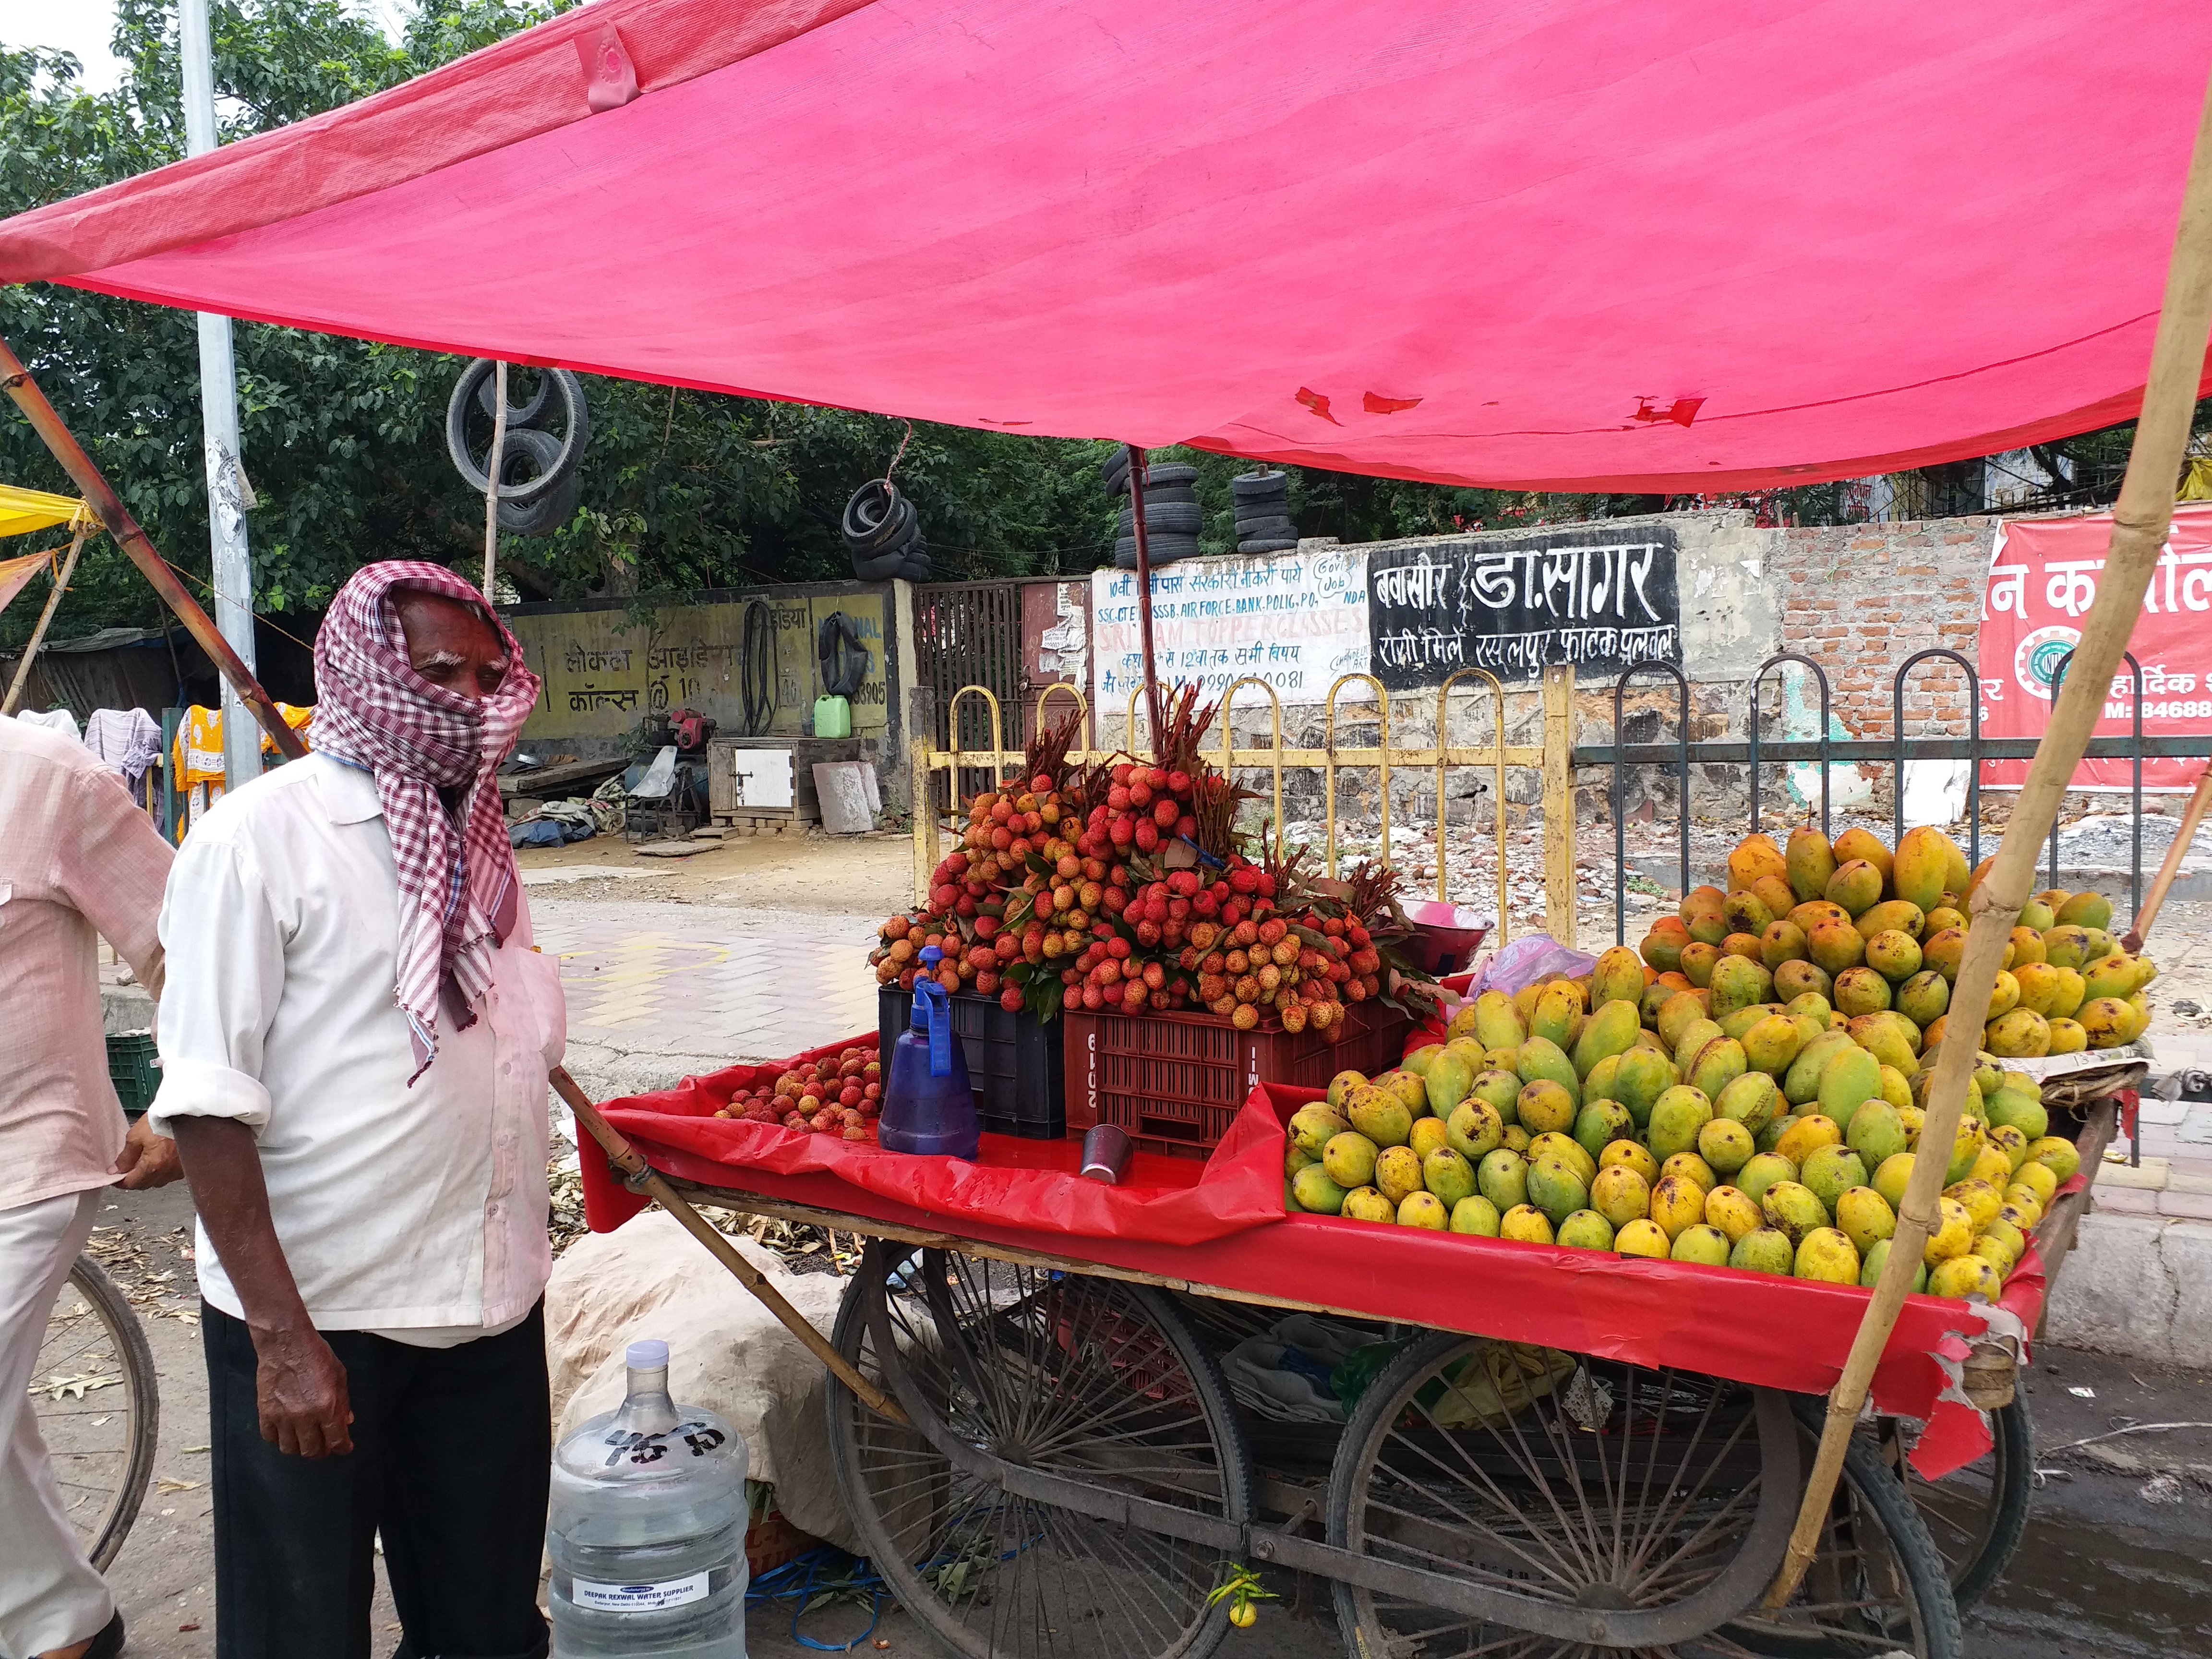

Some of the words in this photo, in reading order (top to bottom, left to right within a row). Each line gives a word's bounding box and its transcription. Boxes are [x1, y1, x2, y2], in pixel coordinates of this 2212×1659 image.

[1343, 589, 1366, 604] NDA
[584, 1590, 607, 1599] DEEPAK
[663, 1585, 694, 1597] SUPPLIER
